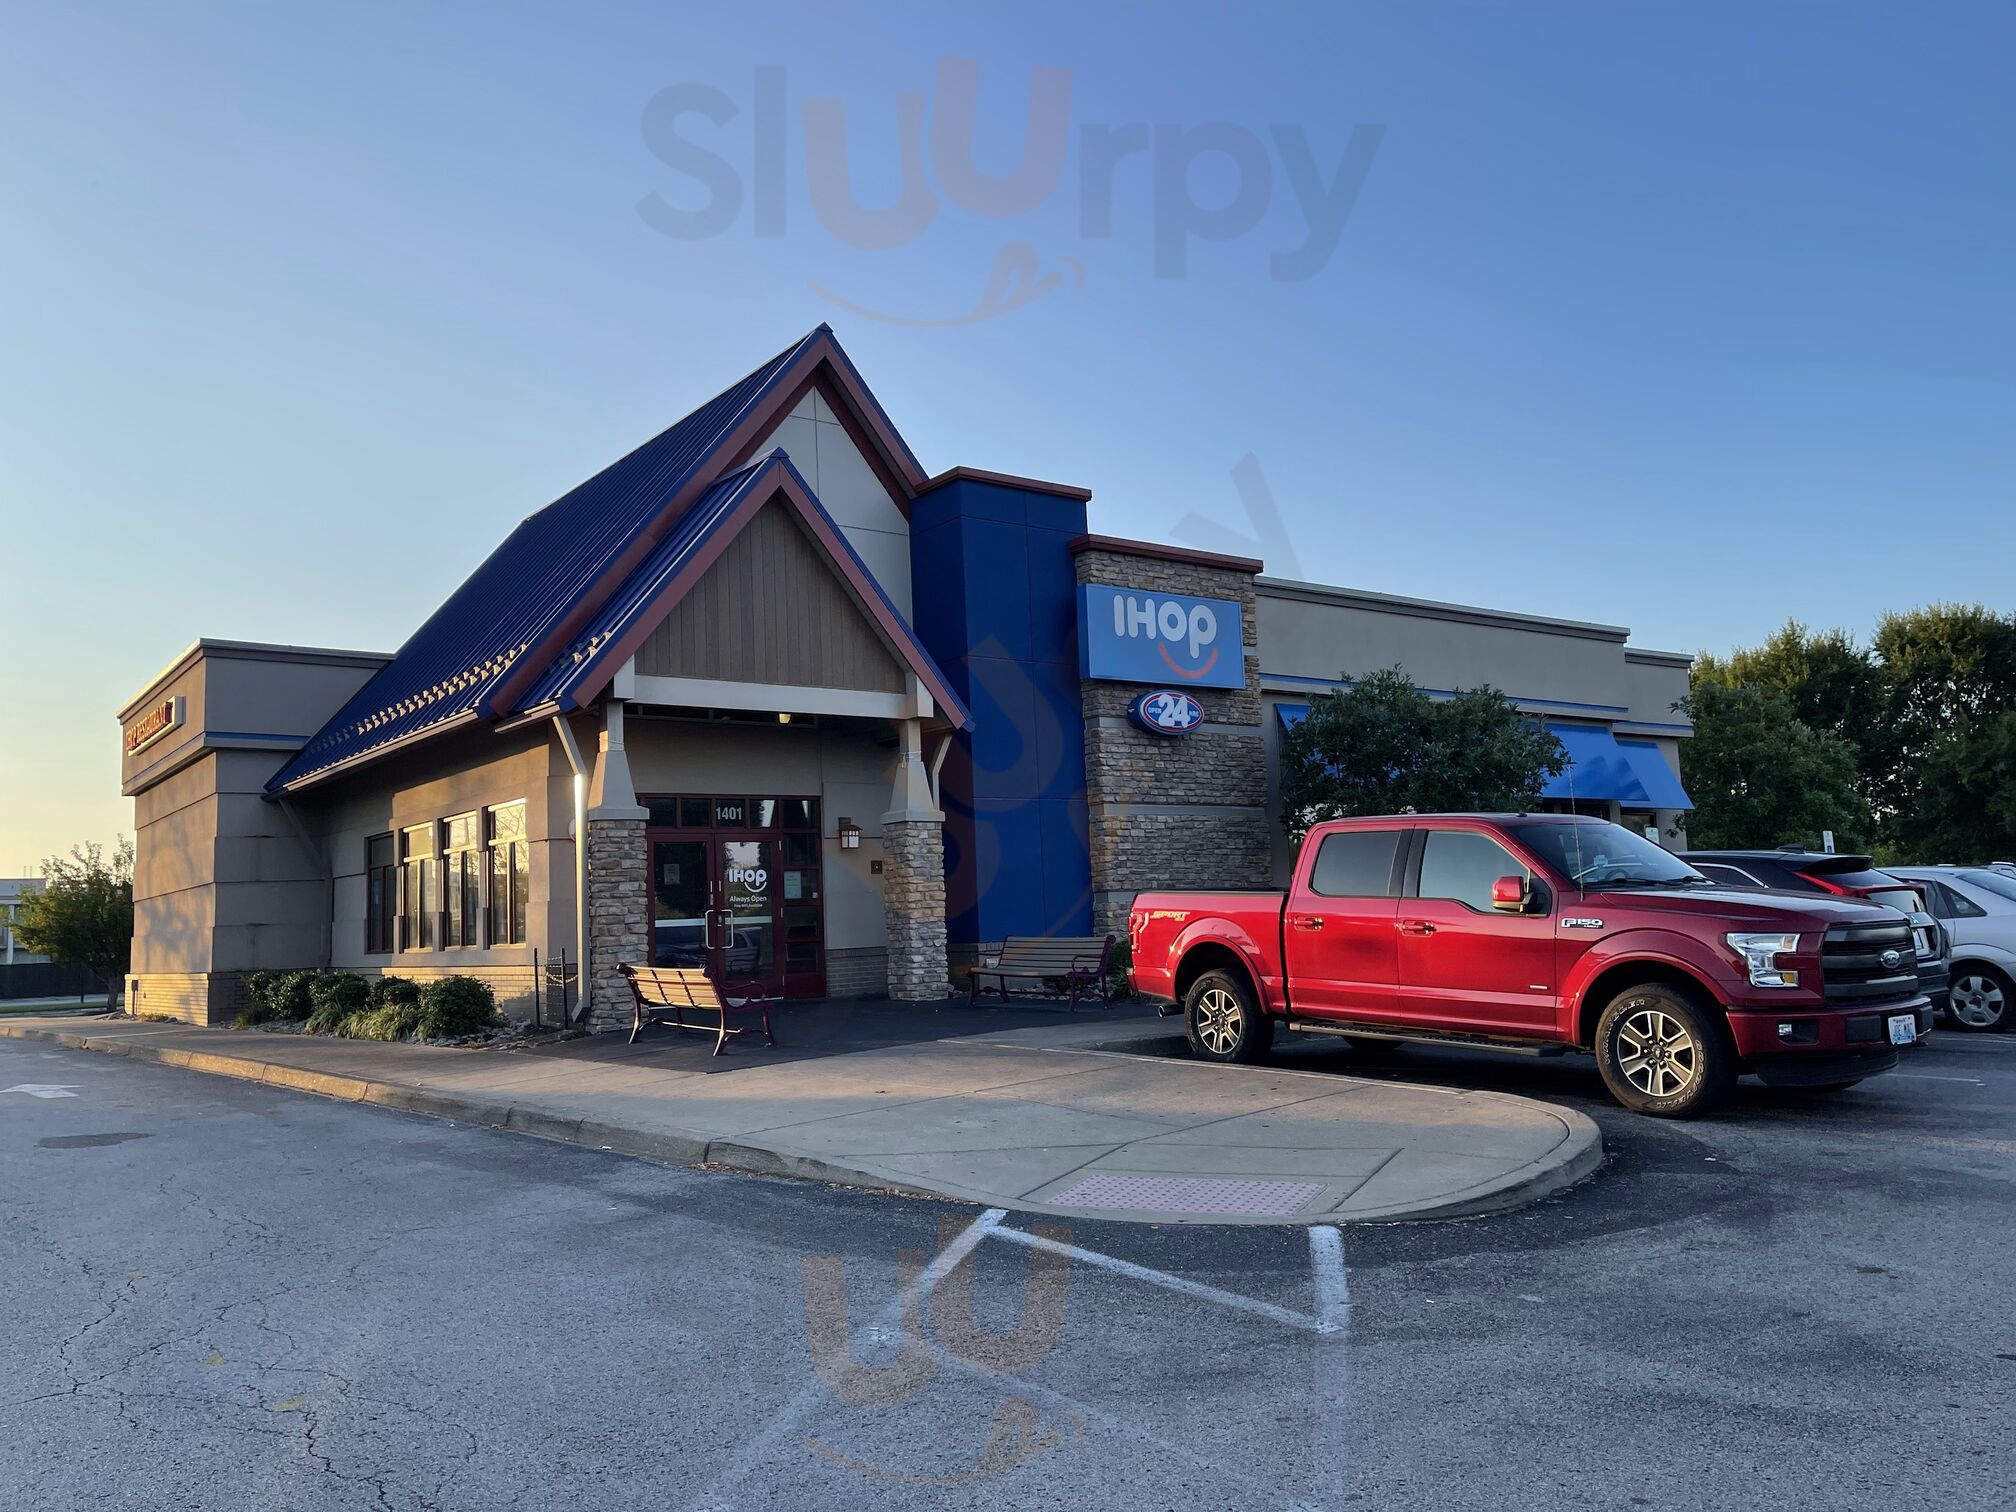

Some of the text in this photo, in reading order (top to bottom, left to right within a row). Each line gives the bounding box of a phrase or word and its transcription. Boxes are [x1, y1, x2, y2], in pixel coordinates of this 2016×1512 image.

[1113, 594, 1217, 659] IHOP
[1158, 694, 1191, 728] 24
[715, 806, 743, 821] 1401
[728, 869, 767, 886] IHOP
[729, 894, 767, 903] Always Open
